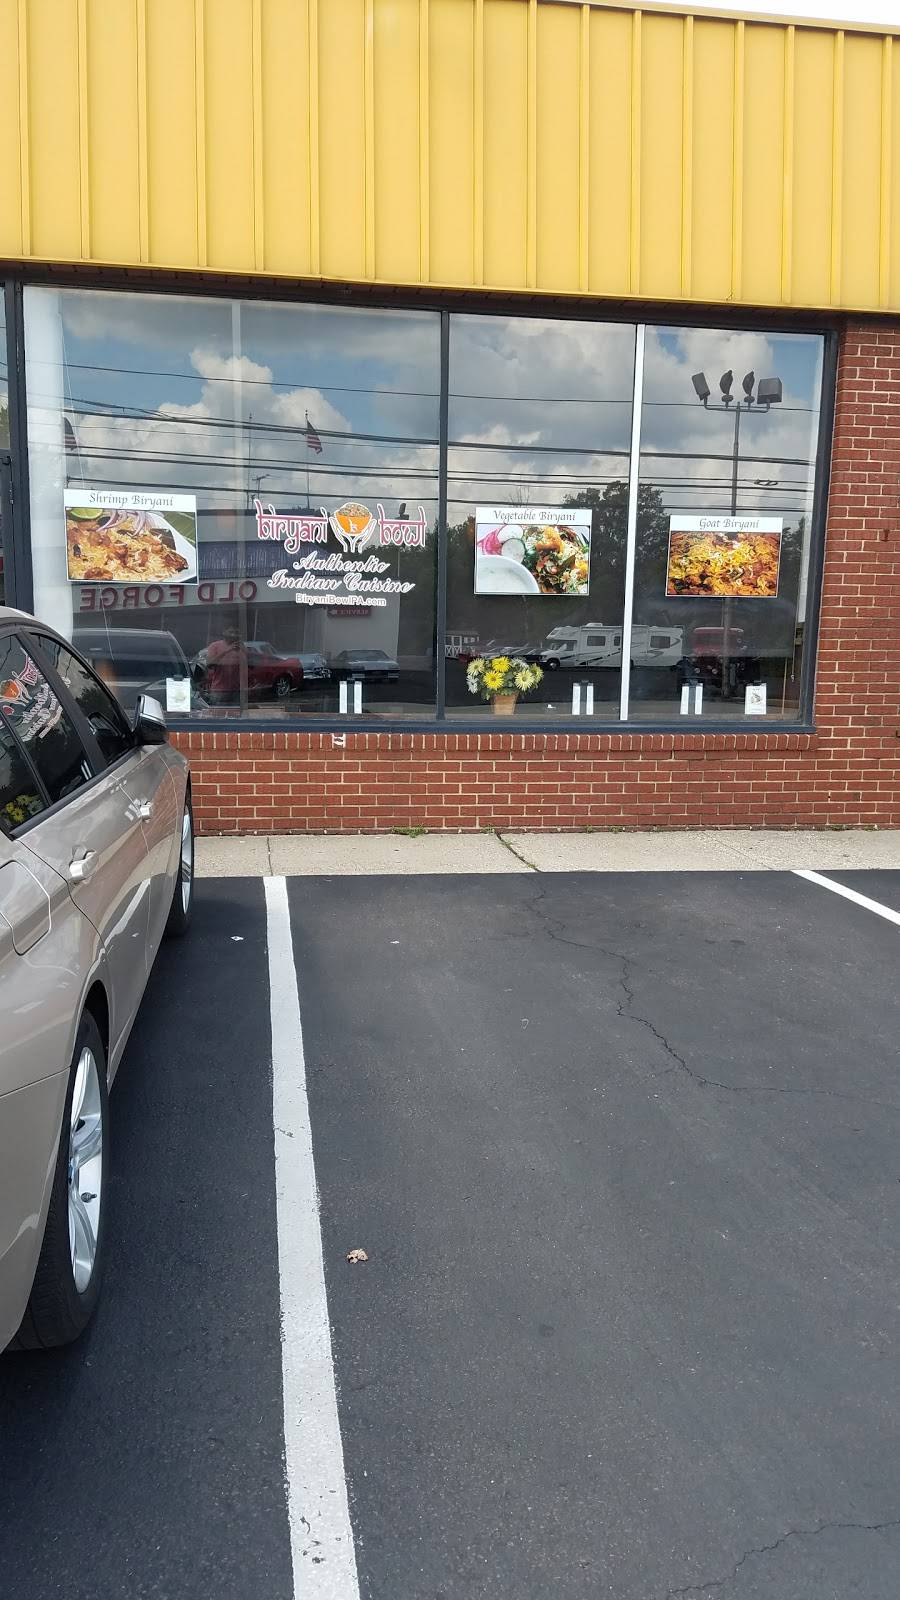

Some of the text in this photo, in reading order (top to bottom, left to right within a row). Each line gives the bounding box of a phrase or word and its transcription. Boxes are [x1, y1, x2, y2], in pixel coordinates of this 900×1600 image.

[89, 492, 174, 509] Shrimp Biryani
[254, 499, 328, 554] biryani
[377, 503, 427, 547] bowl
[493, 509, 577, 526] Vegetable Biryani
[699, 518, 760, 531] Goat Biryani
[293, 551, 390, 573] Authentic
[267, 569, 416, 593] Indian Cuisine
[296, 593, 387, 606] BiryaniBowlPA.com
